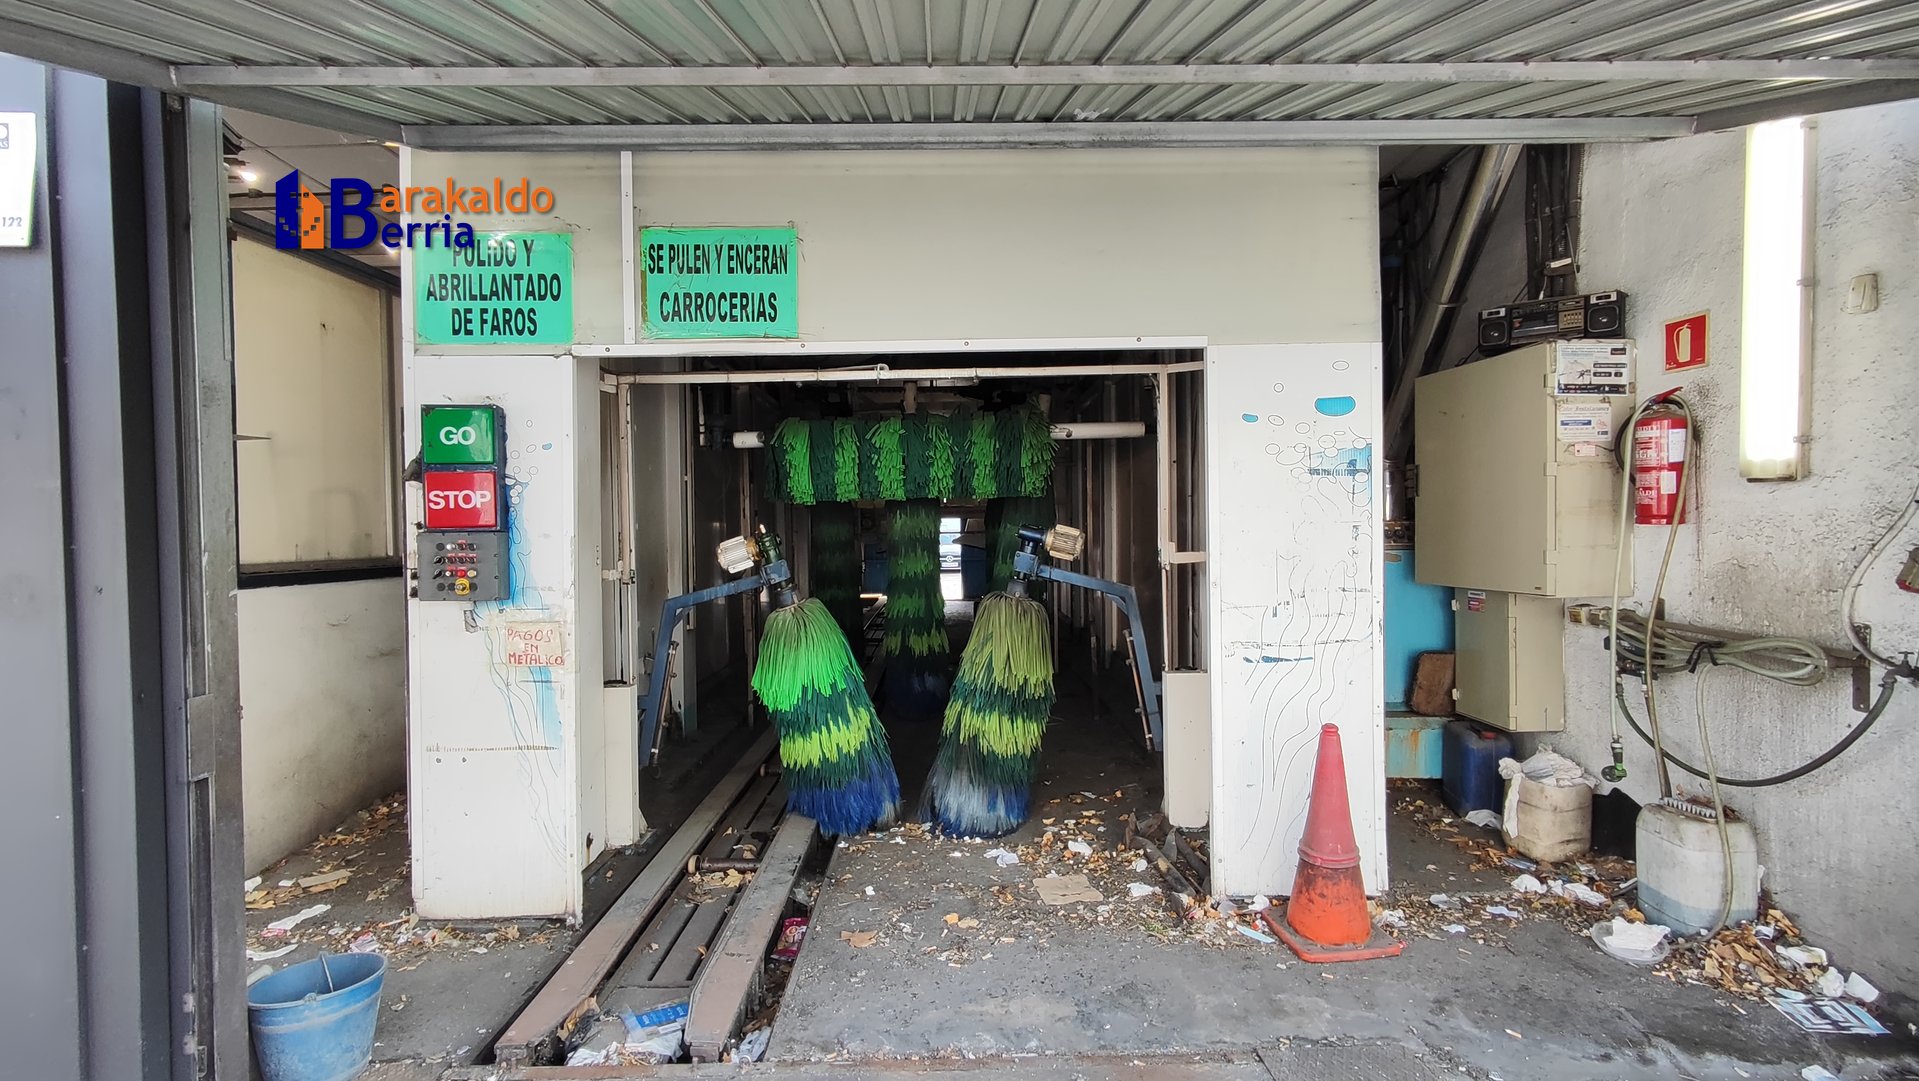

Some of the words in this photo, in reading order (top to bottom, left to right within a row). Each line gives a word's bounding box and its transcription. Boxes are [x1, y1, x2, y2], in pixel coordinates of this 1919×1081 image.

[525, 240, 535, 267] Y
[648, 243, 664, 274] SE
[668, 244, 710, 274] PULEN
[714, 244, 724, 274] Y
[727, 244, 788, 274] ENCERAN
[426, 273, 562, 302] ABRILLANTADO
[659, 291, 778, 323] CARROCERIAS
[451, 307, 474, 336] DE
[480, 307, 538, 336] FAROS
[439, 426, 476, 445] GO
[428, 489, 492, 510] STOP
[507, 628, 554, 643] PAGOS
[524, 642, 539, 653] EN
